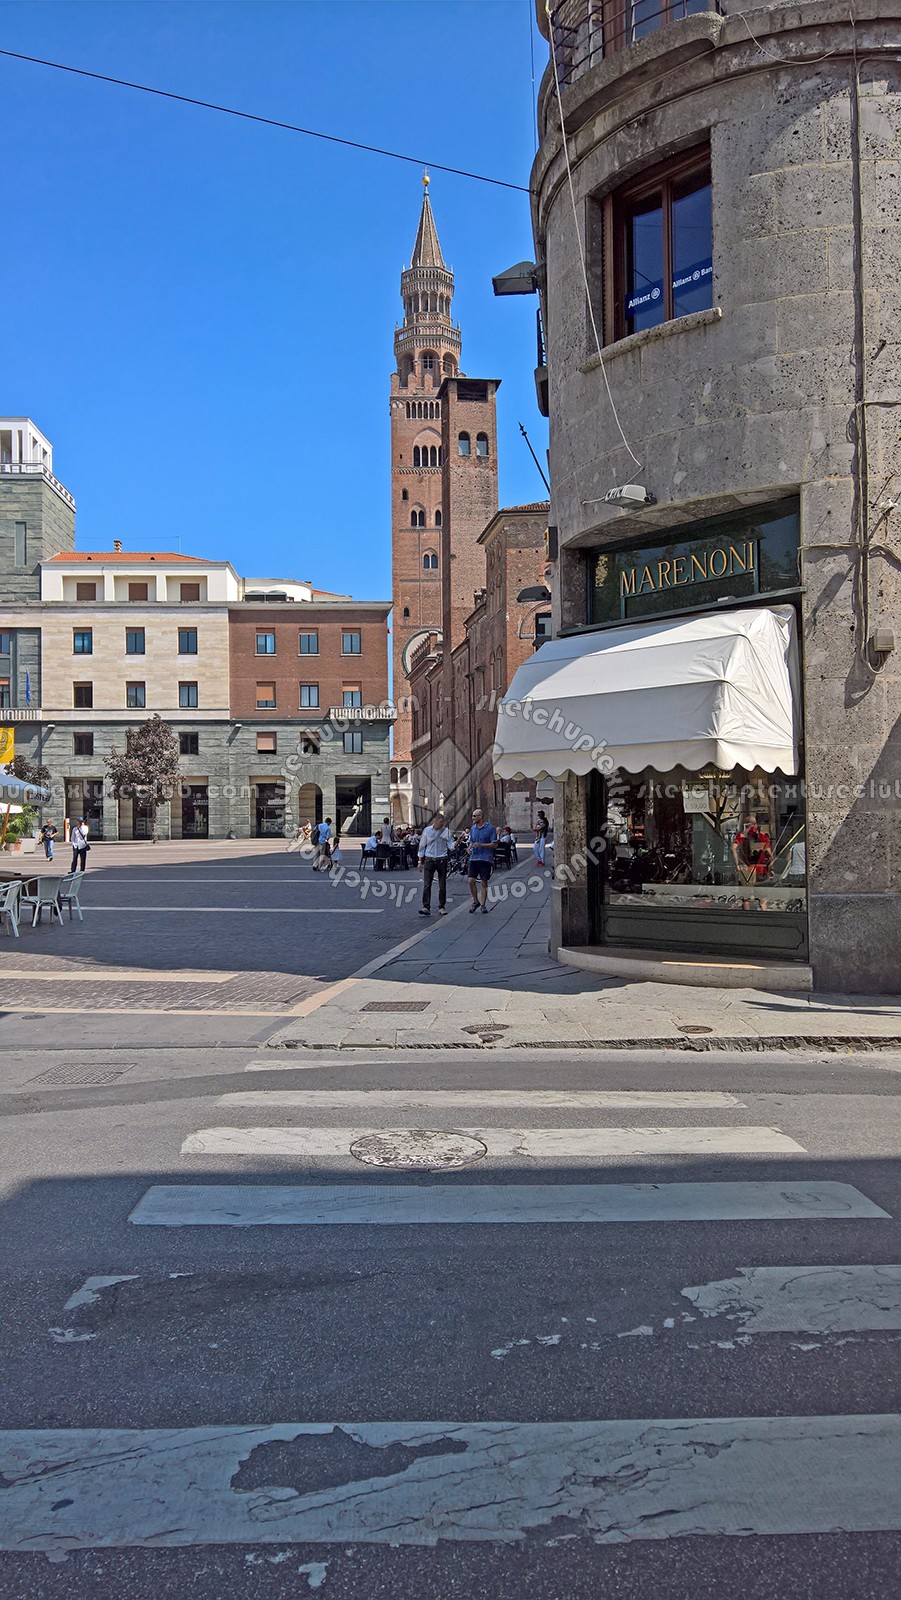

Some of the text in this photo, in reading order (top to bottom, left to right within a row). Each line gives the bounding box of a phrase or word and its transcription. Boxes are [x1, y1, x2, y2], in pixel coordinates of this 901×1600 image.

[672, 275, 692, 289] Allianz
[628, 293, 651, 308] Allianz
[620, 541, 755, 596] MARENONI
